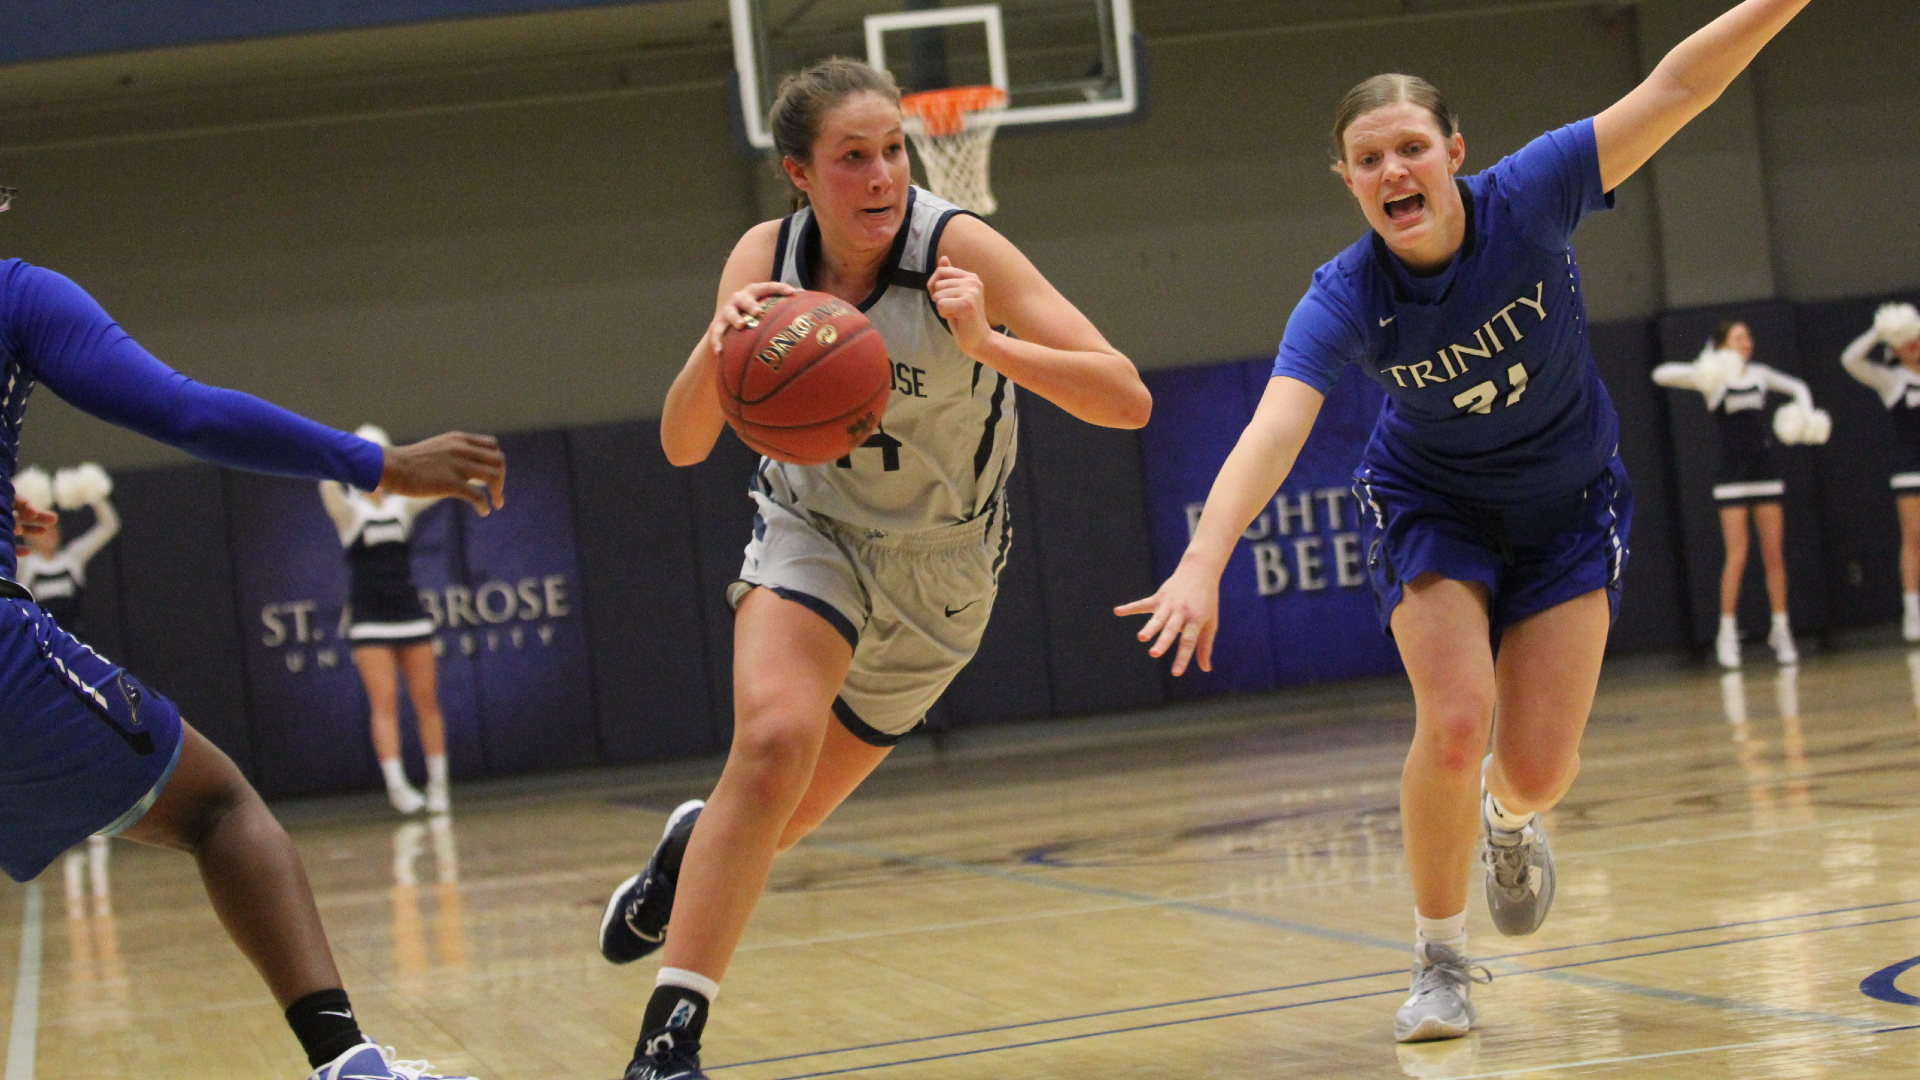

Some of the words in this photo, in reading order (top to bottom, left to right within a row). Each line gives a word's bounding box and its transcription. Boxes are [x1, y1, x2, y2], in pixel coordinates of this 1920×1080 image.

[1380, 280, 1547, 389] TRINITY
[836, 421, 902, 472] 4
[1252, 532, 1366, 596] BEE
[260, 600, 325, 648] ST.
[337, 573, 571, 640] BROSE
